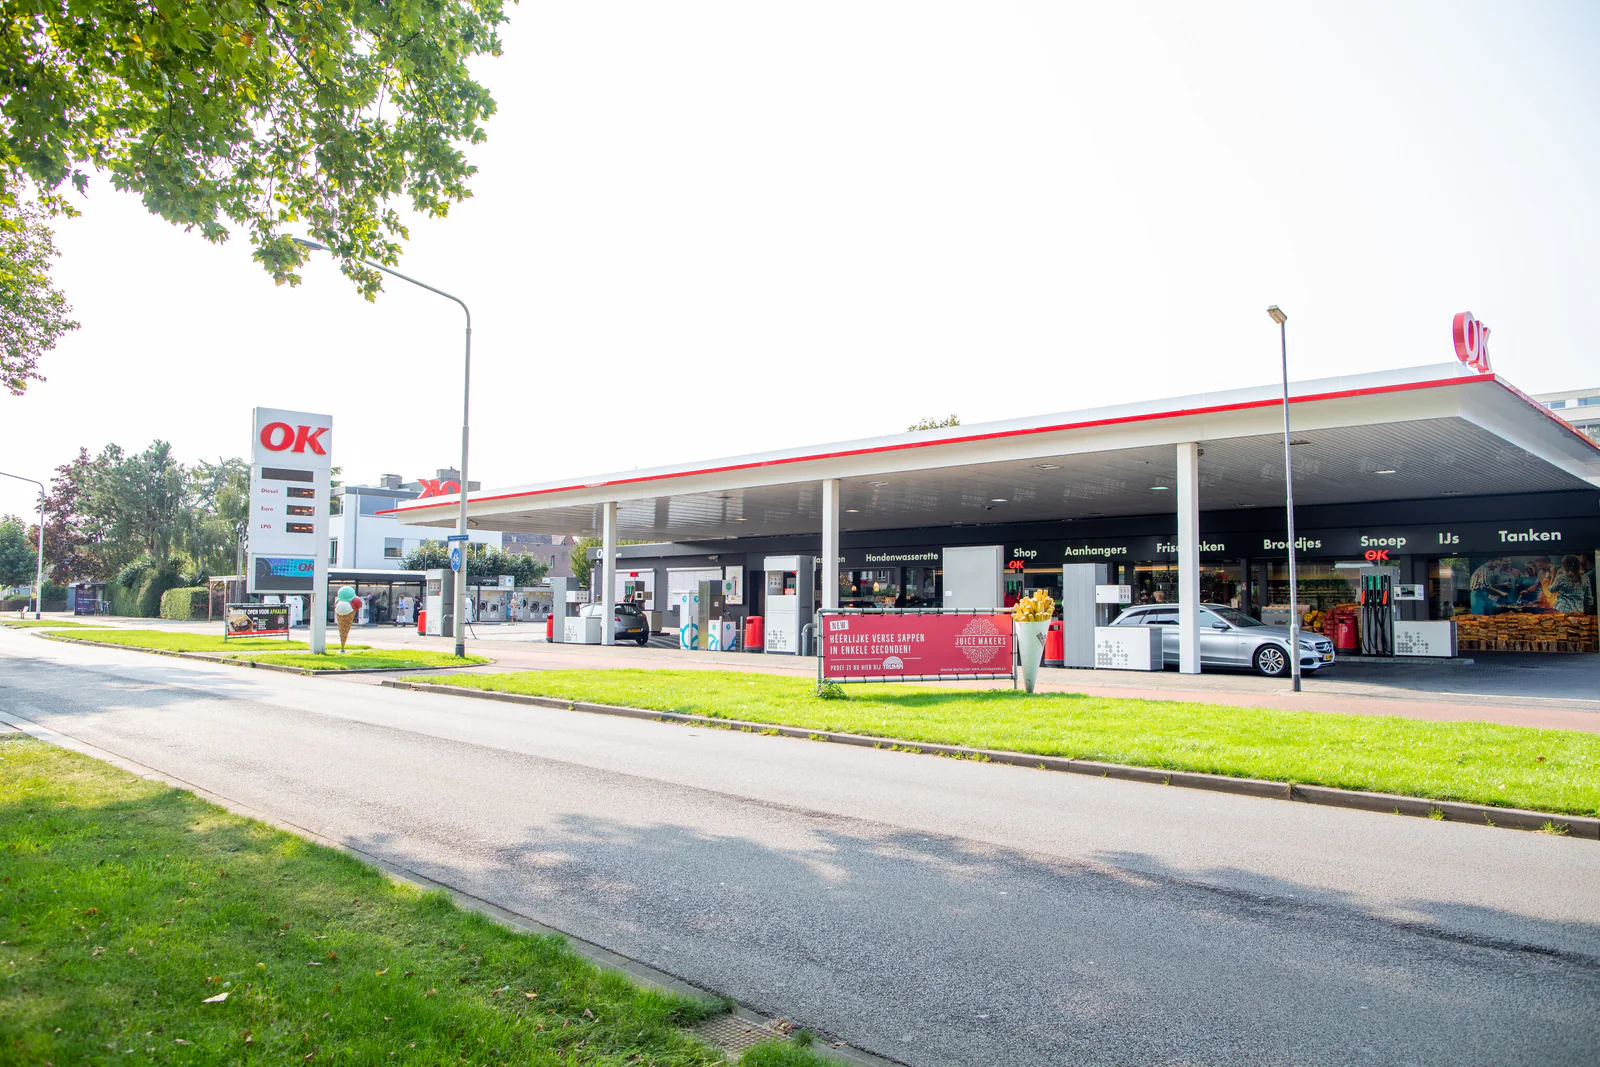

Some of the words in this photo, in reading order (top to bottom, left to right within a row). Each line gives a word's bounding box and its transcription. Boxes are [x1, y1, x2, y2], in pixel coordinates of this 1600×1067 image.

[1453, 311, 1493, 373] OK
[260, 421, 329, 455] OK
[1438, 532, 1460, 544] IJs
[1498, 528, 1562, 543] Tanken
[1360, 535, 1407, 549] Snoep
[1013, 547, 1037, 559] Shop
[1064, 545, 1127, 557] Aanhangers
[1364, 550, 1389, 561] OK
[865, 552, 939, 563] Hondenwasserette
[1008, 560, 1024, 569] OK
[832, 621, 846, 630] NEW
[829, 633, 869, 643] HÉÉRLIJKE
[872, 633, 895, 643] VERSE
[897, 633, 925, 642] SAPPEN
[955, 637, 976, 646] JUICE
[978, 637, 1007, 645] MAKERS
[829, 646, 838, 655] IN
[841, 645, 868, 655] ENKELE
[871, 645, 911, 655] SECONDEN!
